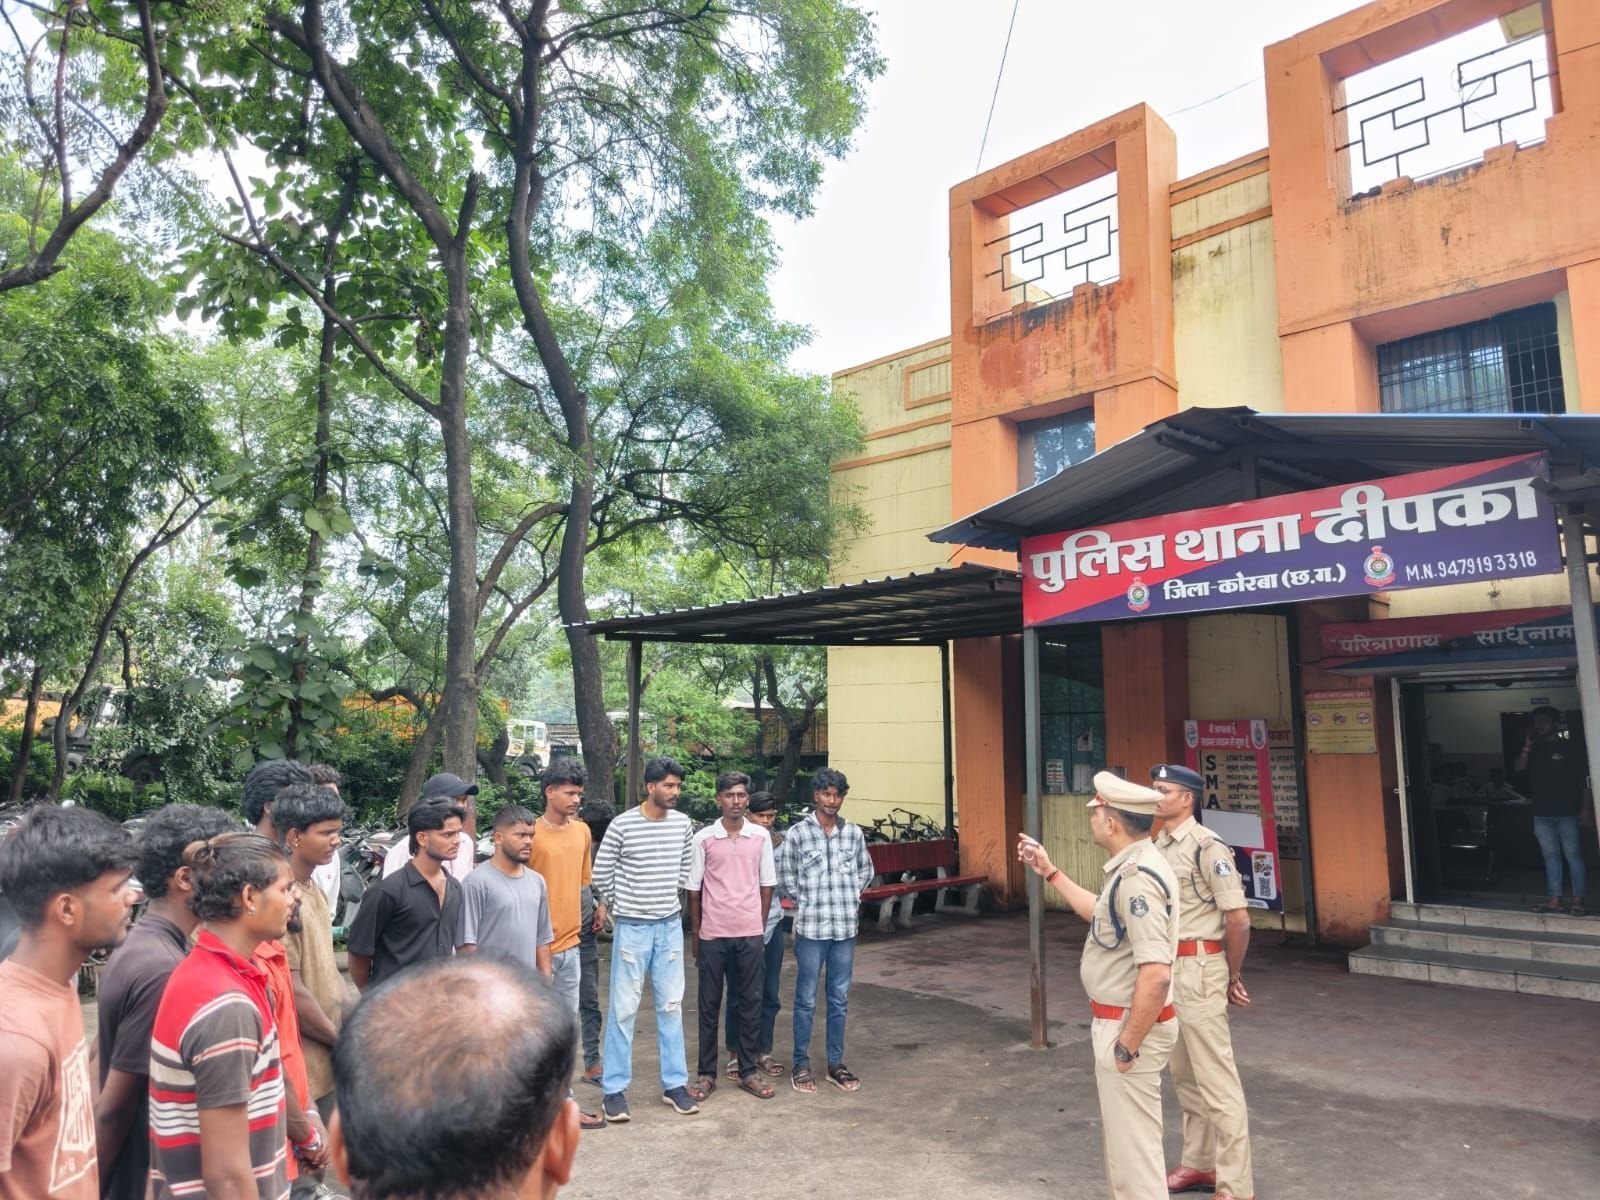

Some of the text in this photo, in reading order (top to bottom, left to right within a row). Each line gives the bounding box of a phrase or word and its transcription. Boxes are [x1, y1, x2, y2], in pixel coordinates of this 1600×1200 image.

[1030, 477, 1539, 593] पुलिस थाना दीपका
[1281, 563, 1347, 589] (छ.ग.)
[1338, 633, 1441, 652] परित्राणाय
[1206, 775, 1219, 790] M
